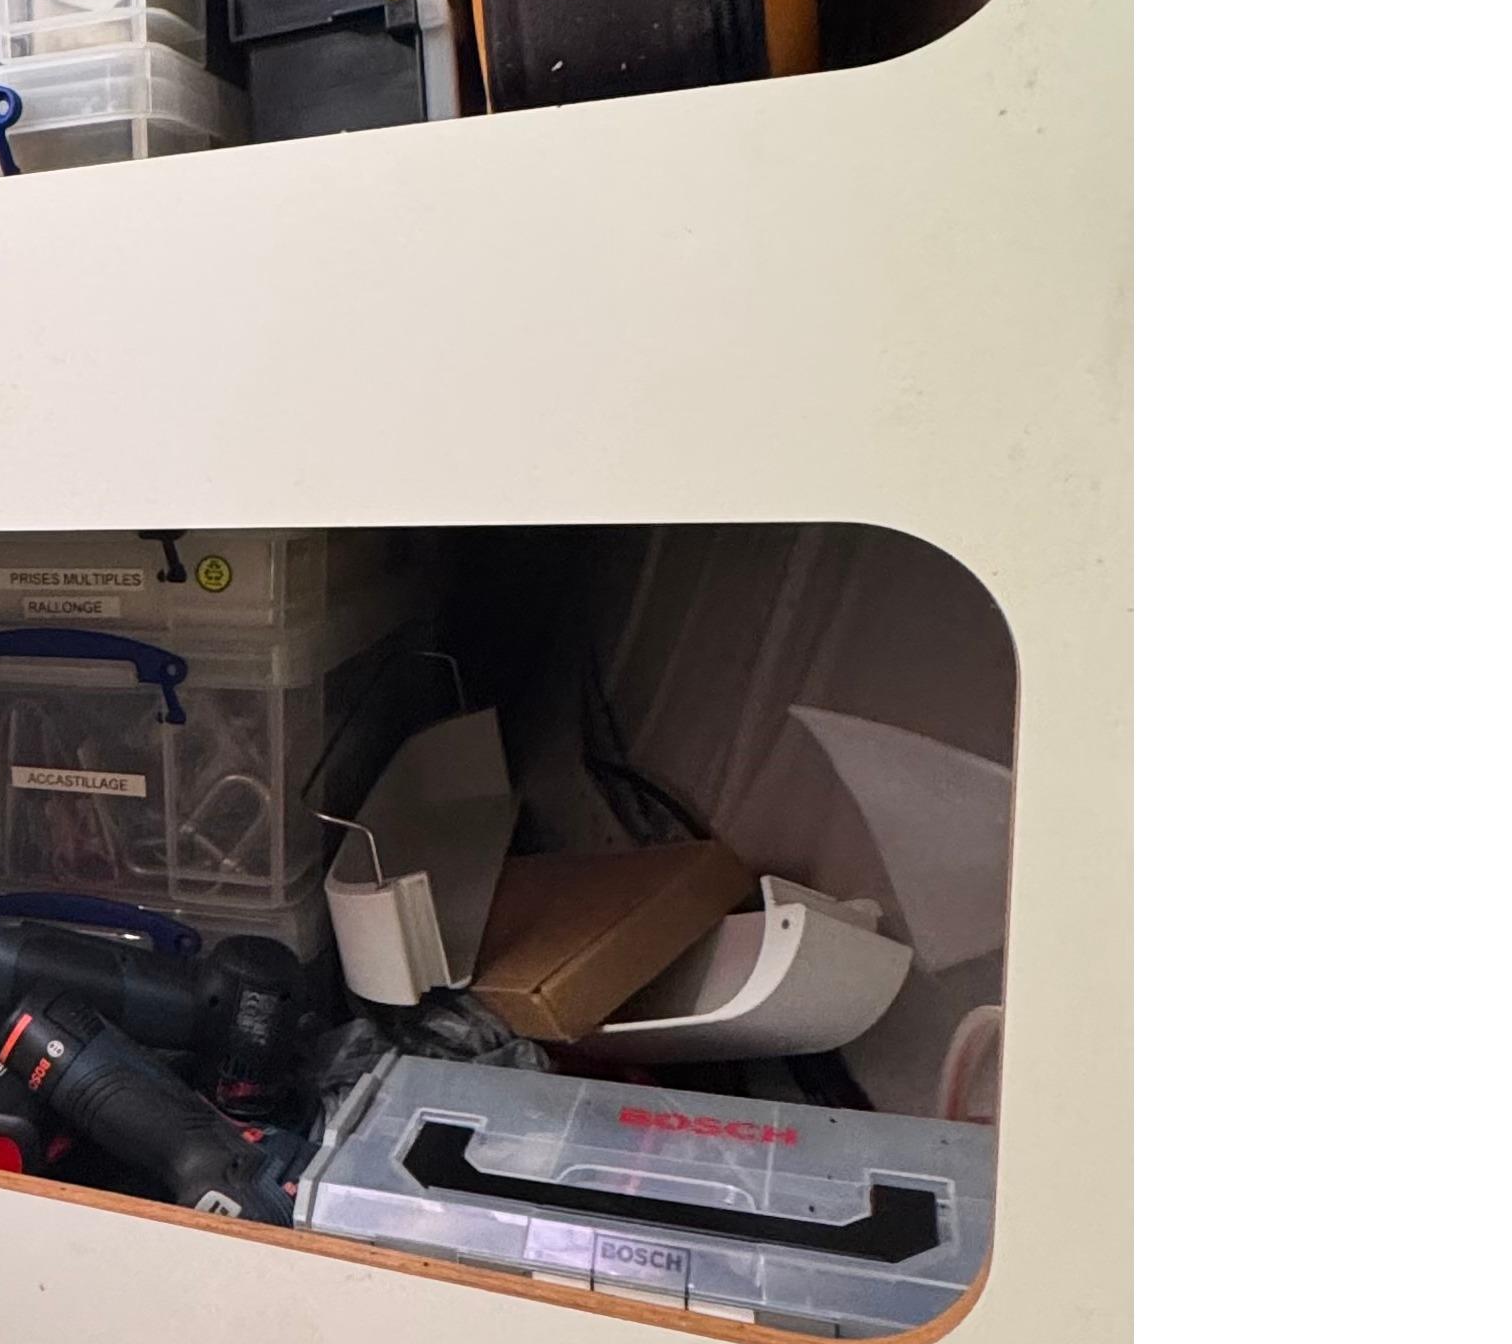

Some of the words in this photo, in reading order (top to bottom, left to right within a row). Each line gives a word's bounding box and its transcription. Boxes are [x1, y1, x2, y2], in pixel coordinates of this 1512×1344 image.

[9, 572, 61, 586] PRISES
[62, 572, 142, 587] MULTIPLES
[28, 600, 103, 614] RALLONGE
[27, 772, 129, 792] ACCASTILLAGE
[618, 1106, 799, 1147] BOSCH
[600, 1241, 683, 1273] BOSCH
